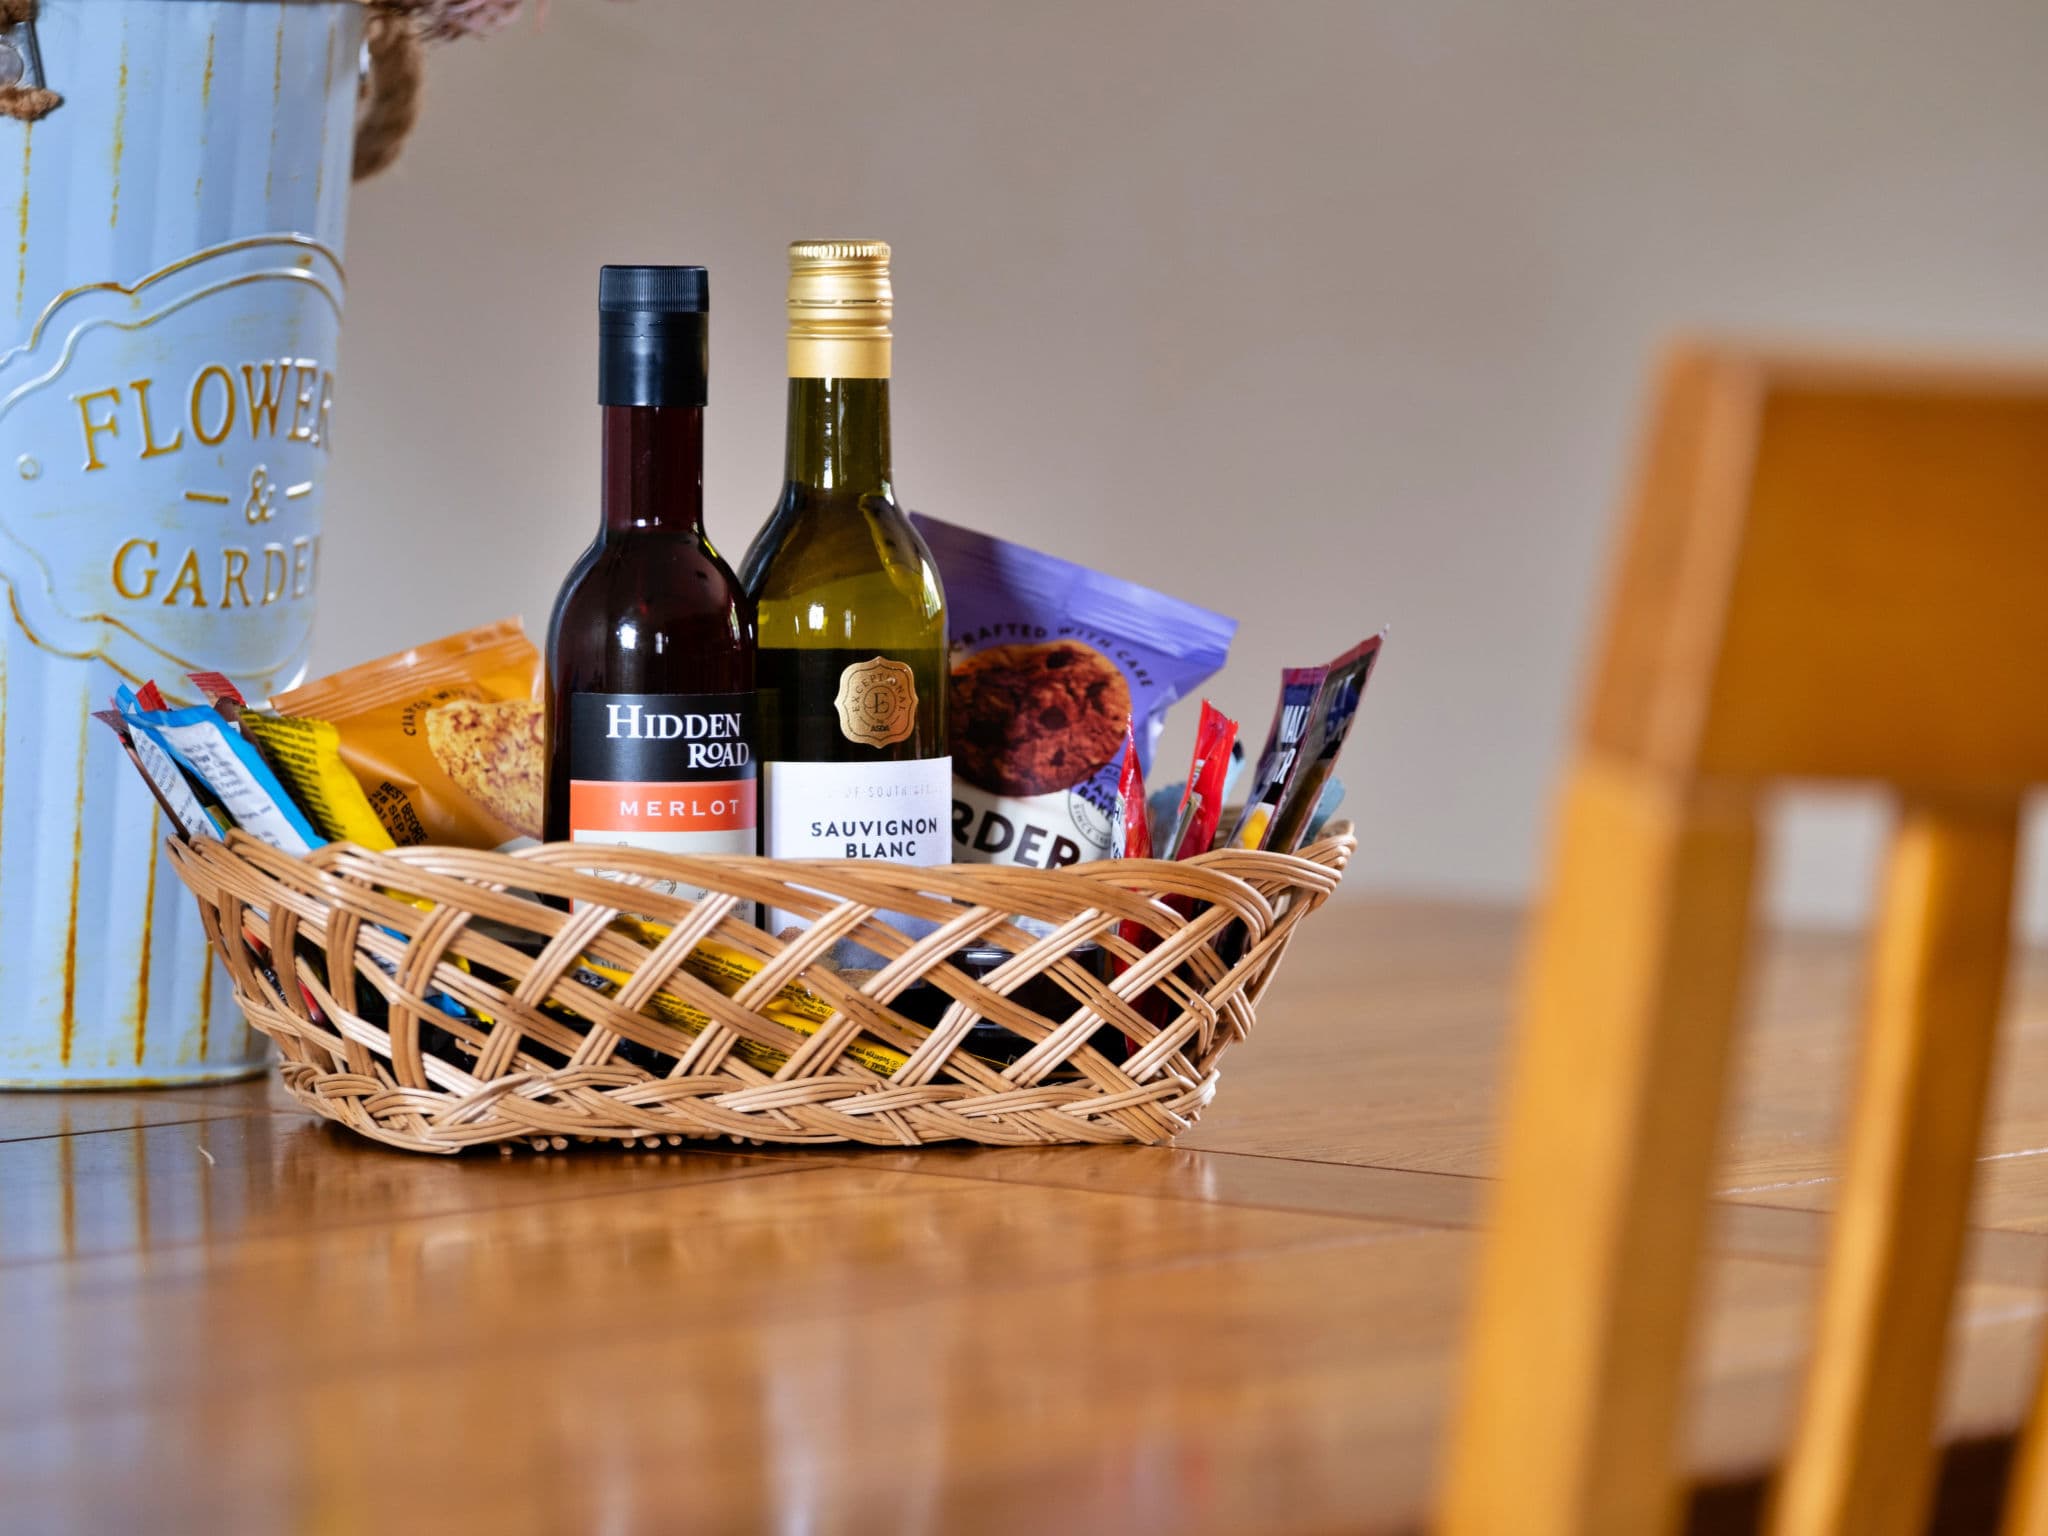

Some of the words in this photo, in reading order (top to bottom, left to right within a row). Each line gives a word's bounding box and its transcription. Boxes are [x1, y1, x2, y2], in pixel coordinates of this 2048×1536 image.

[1056, 626, 1112, 648] WITH
[1116, 650, 1154, 687] CARE
[605, 703, 742, 739] HIDDEN
[687, 742, 750, 769] ROAD
[380, 781, 408, 804] BEST
[400, 802, 429, 846] BEFORE
[620, 799, 739, 817] MERLOT
[811, 817, 938, 838] SAUVIGNON
[845, 840, 917, 859] BLANC
